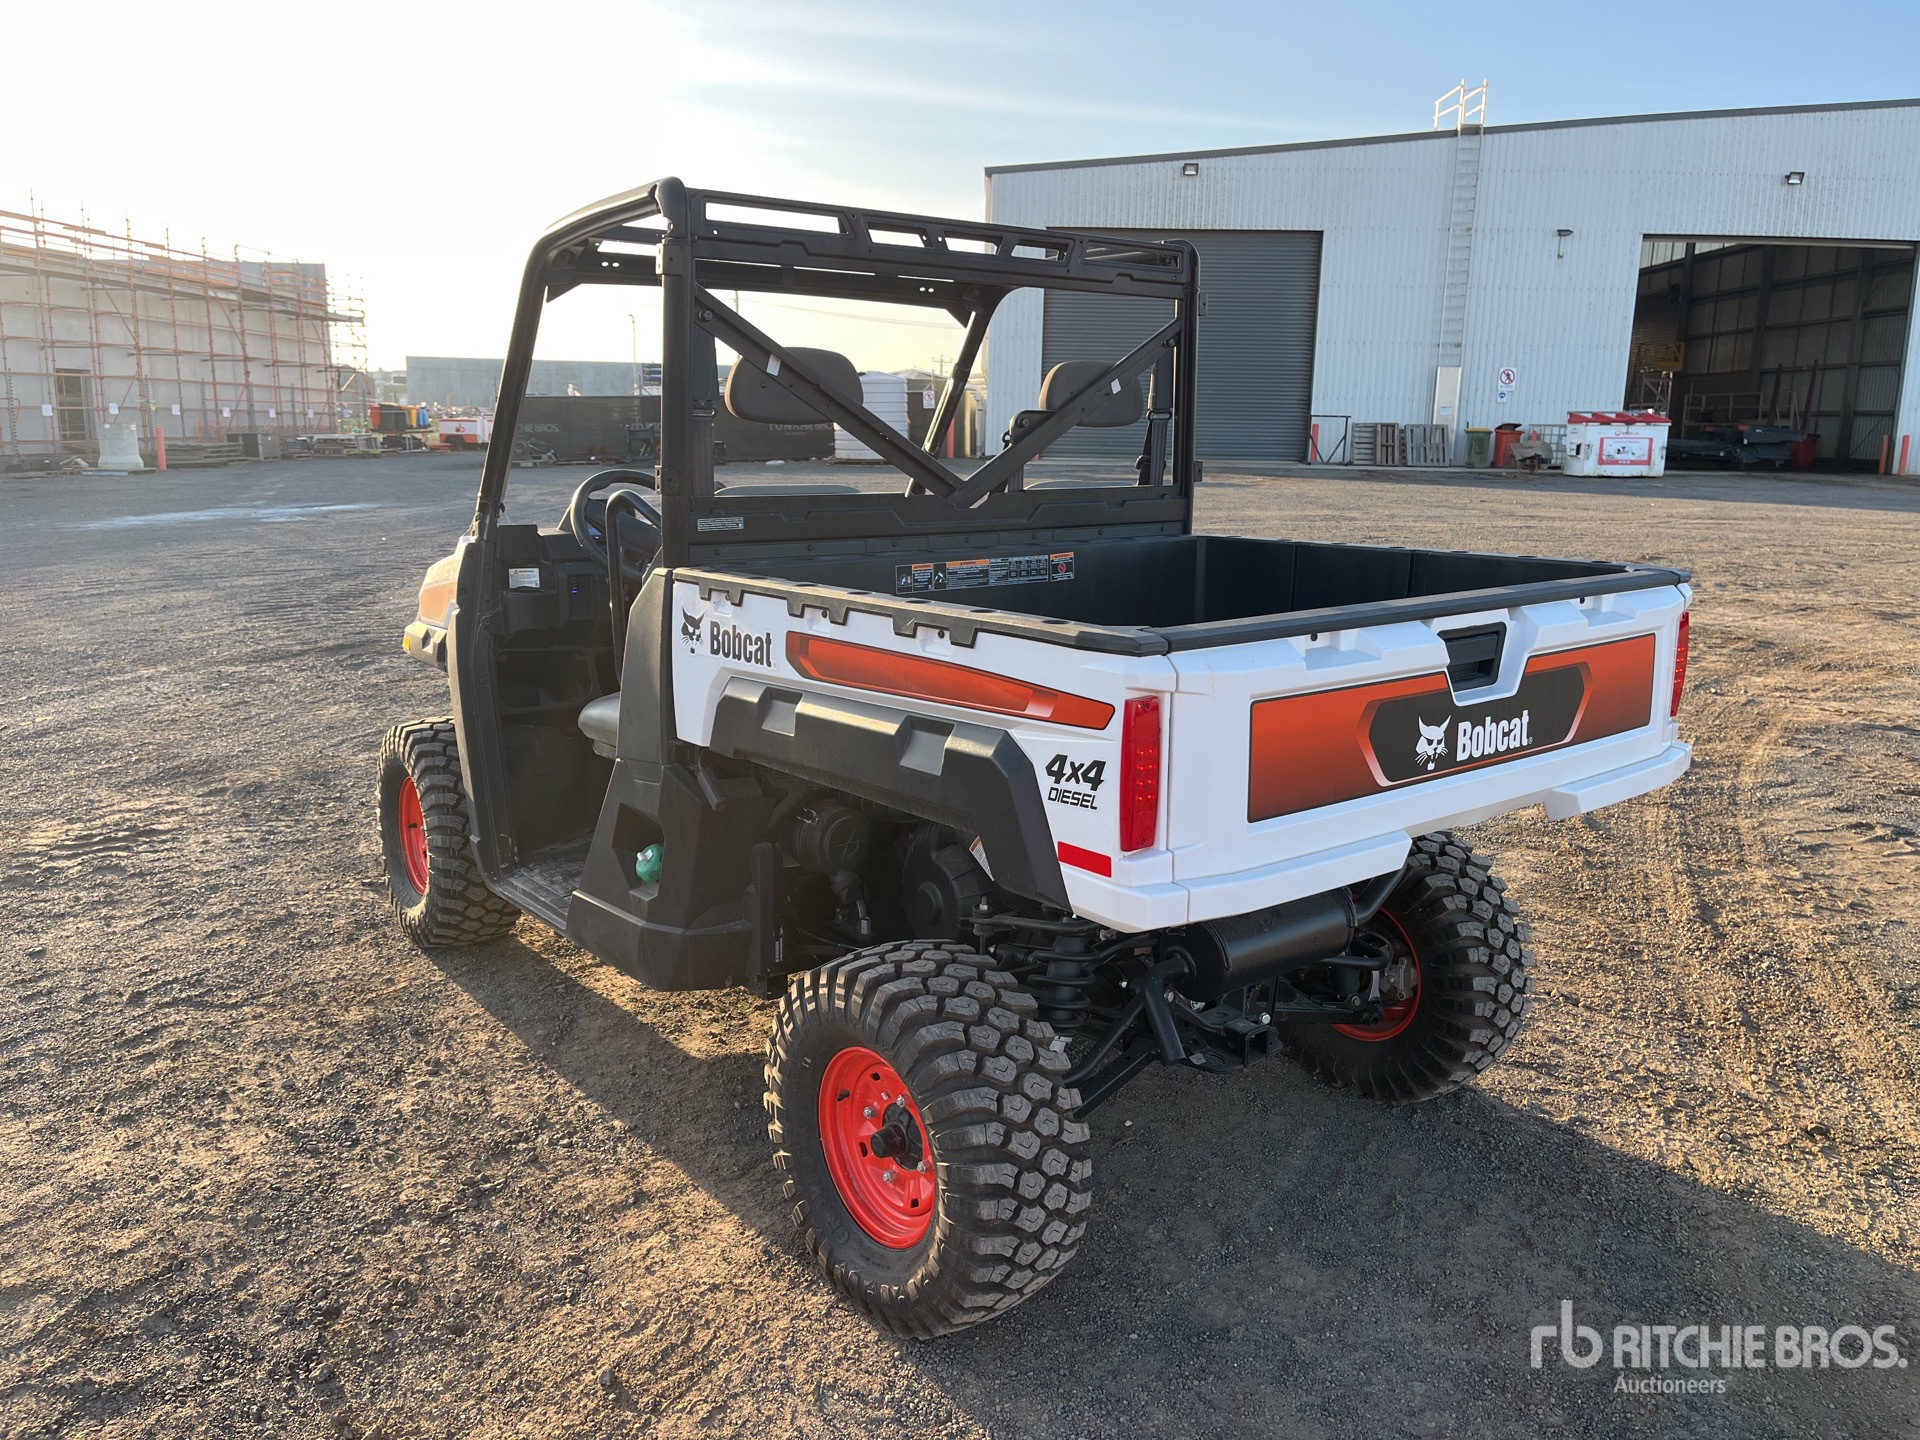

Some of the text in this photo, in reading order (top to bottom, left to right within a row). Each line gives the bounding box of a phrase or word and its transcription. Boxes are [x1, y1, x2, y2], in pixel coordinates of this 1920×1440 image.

[710, 620, 772, 668] Bobcat
[1456, 709, 1530, 762] Bobcat
[1045, 753, 1106, 792] 4x4
[1047, 786, 1098, 811] DIESEL
